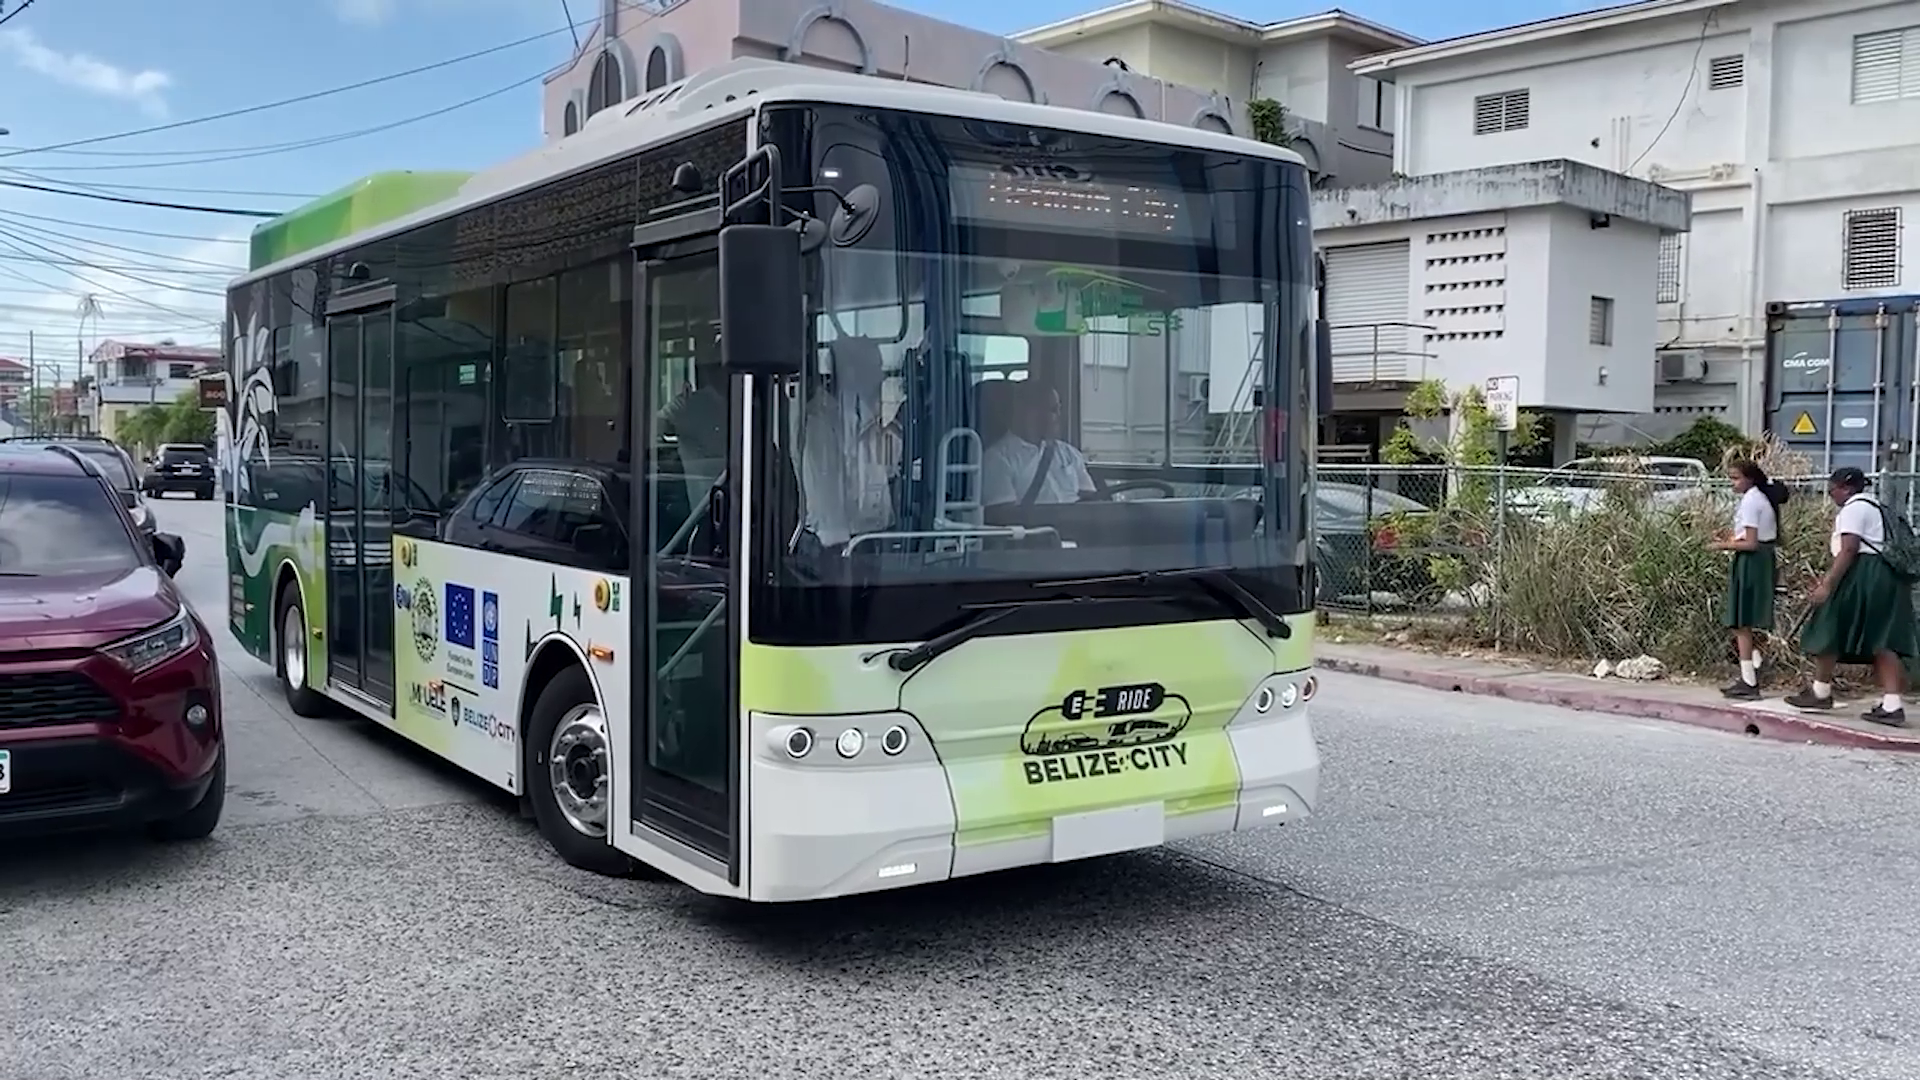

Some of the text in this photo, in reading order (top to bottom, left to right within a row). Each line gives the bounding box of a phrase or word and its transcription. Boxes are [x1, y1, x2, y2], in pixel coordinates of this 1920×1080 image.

[1783, 358, 1806, 368] CMA
[1070, 687, 1152, 713] E RIDE
[463, 707, 489, 731] BELIZE
[497, 722, 515, 742] CITY
[1023, 742, 1187, 784] BELIZE CITY
